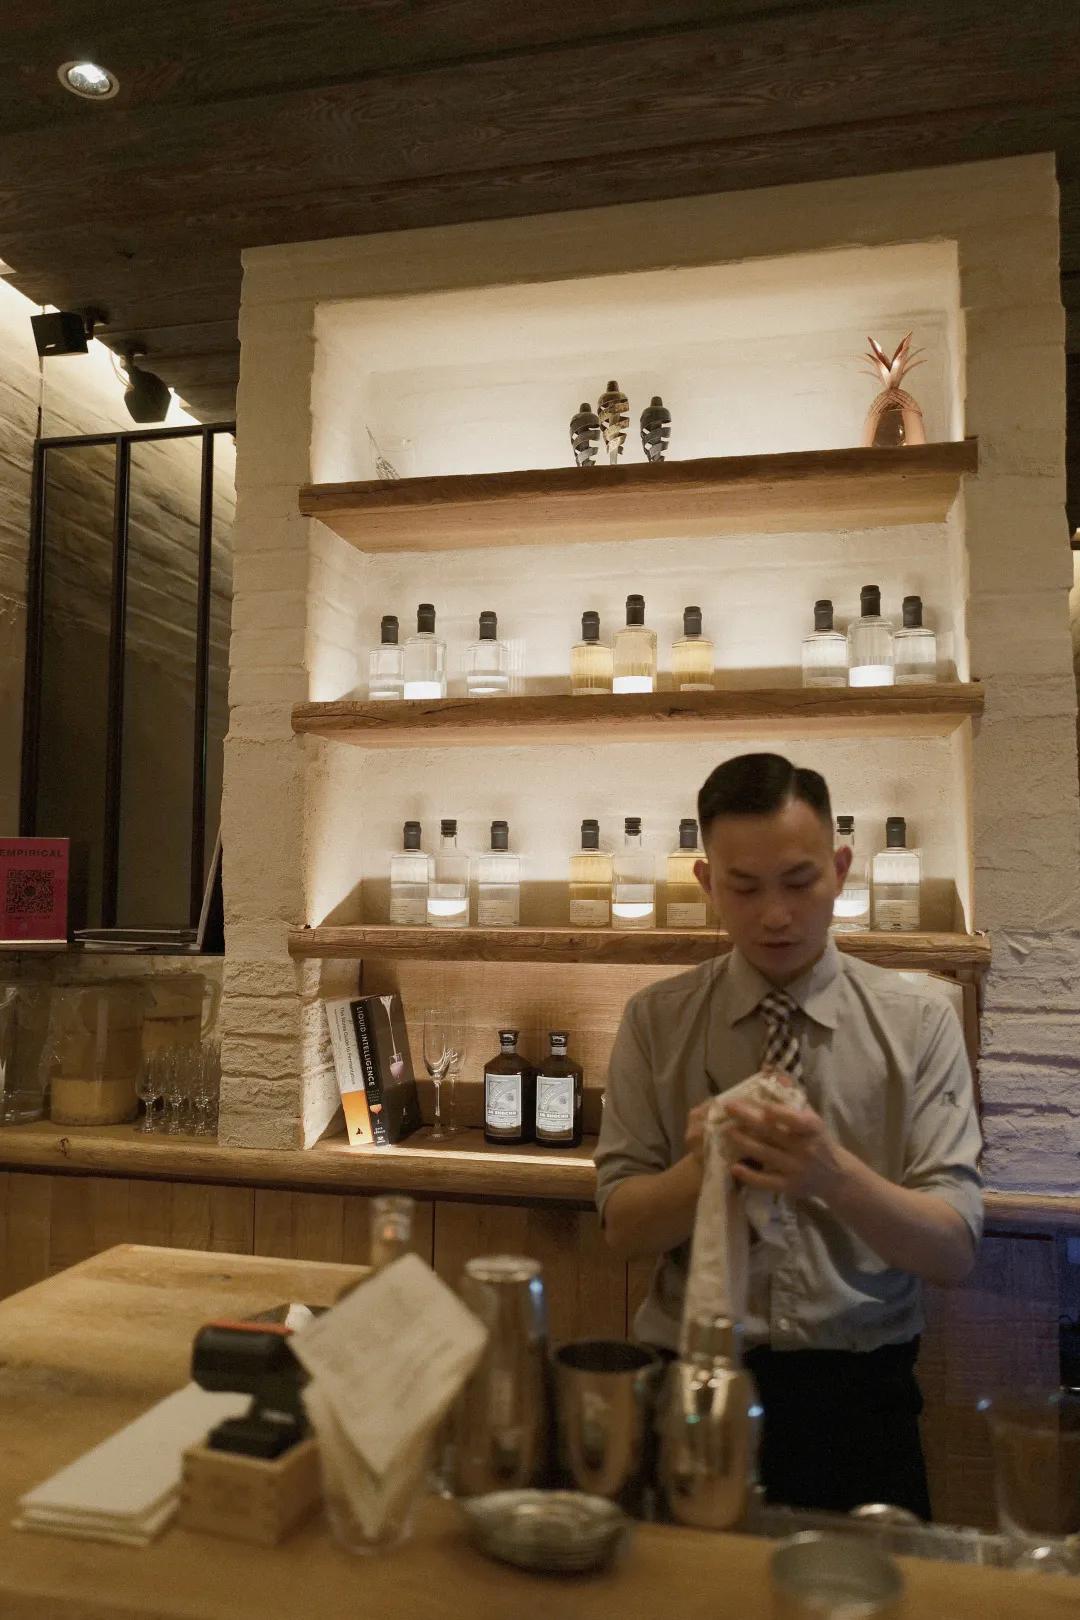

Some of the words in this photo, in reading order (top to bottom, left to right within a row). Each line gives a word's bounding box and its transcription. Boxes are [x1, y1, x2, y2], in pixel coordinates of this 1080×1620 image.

[0, 849, 64, 857] EMPIRICAL
[356, 1006, 367, 1033] LIQUID
[361, 1033, 376, 1087] INTELLIGENCE
